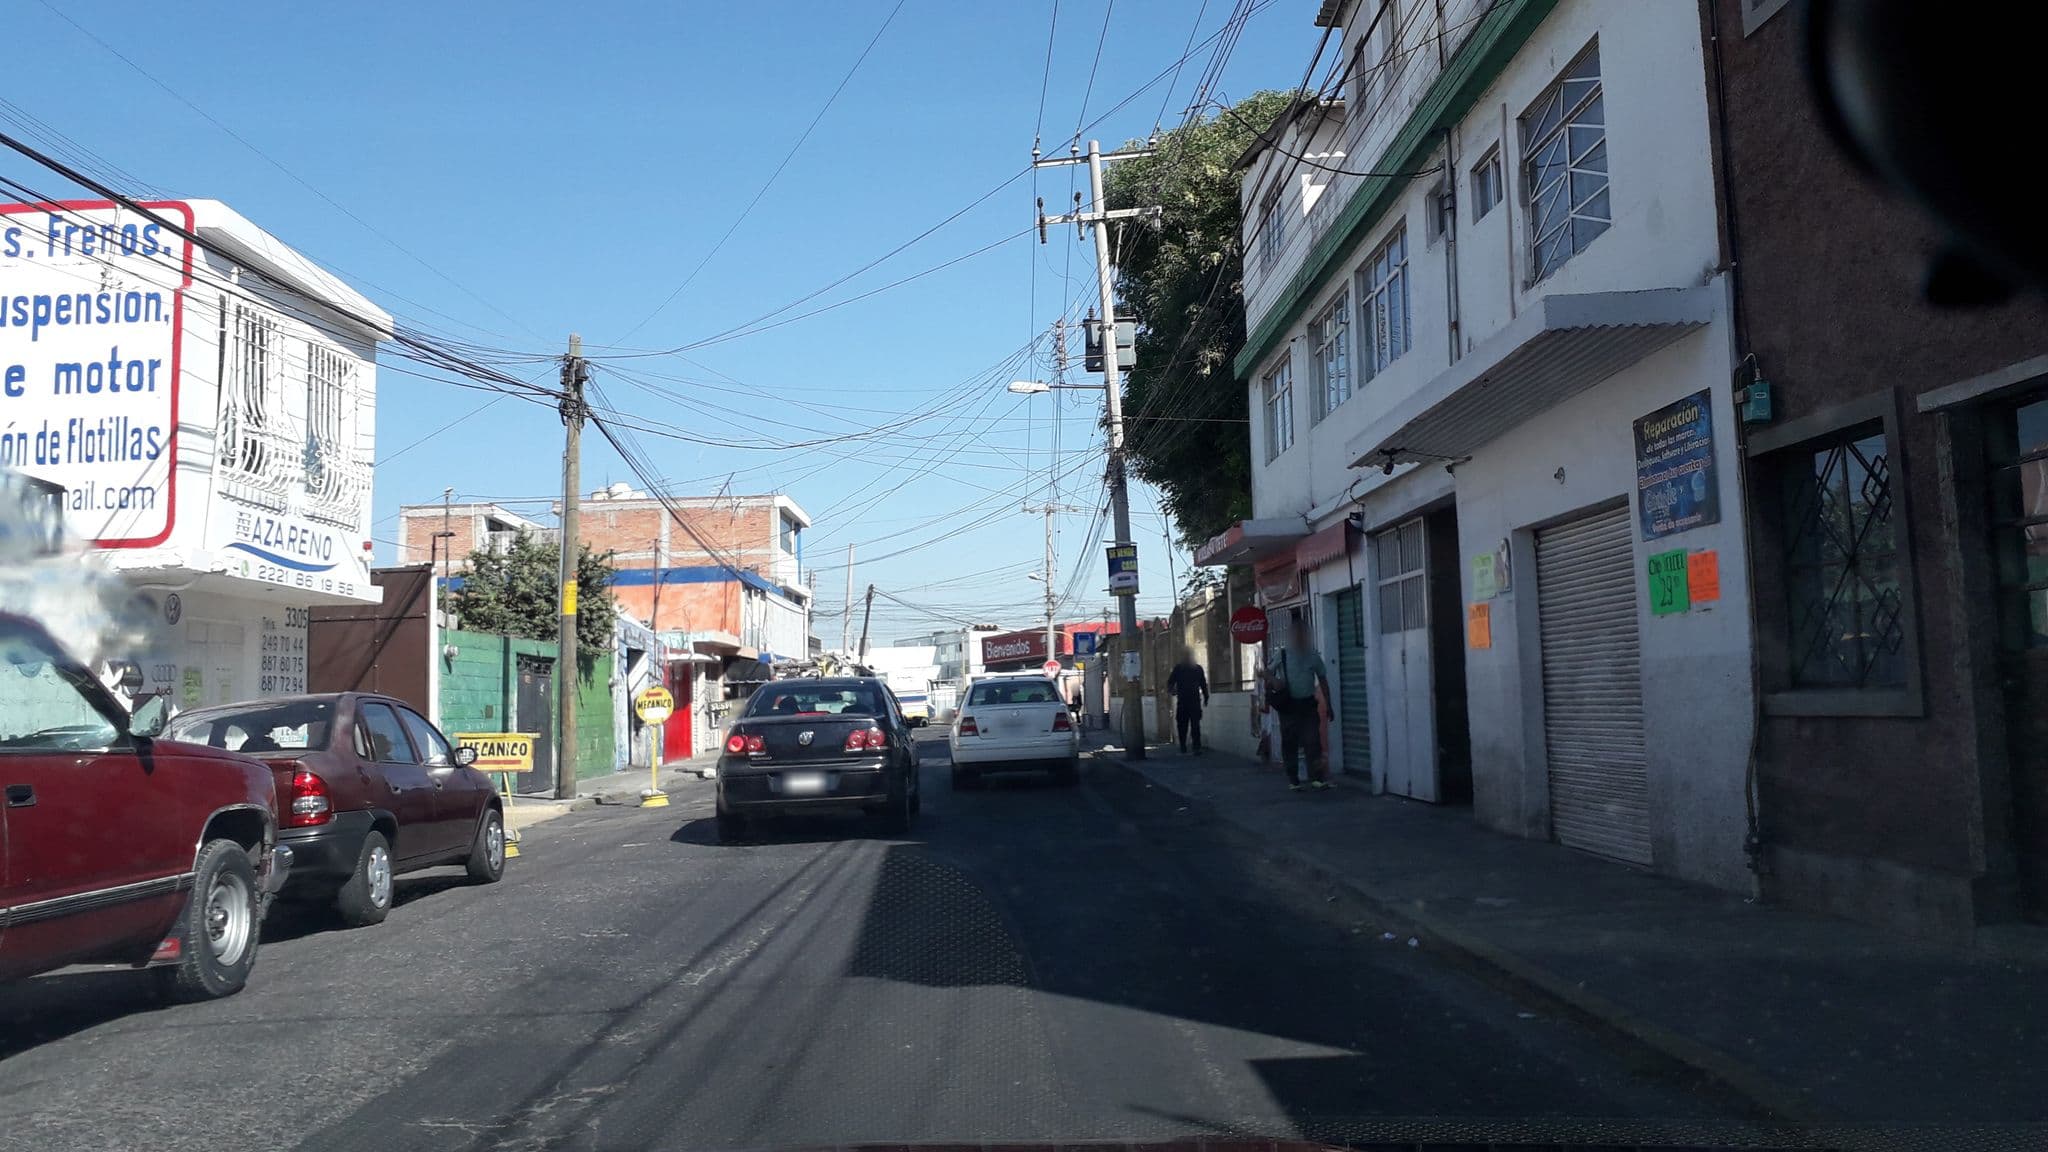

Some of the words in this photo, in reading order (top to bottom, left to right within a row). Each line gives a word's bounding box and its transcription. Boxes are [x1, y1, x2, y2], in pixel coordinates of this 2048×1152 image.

[54, 345, 162, 394] motor
[1643, 403, 1698, 440] Reparación
[35, 419, 60, 465] de
[258, 564, 288, 584] 2221
[295, 572, 314, 588] 86
[293, 637, 304, 653] 44
[985, 639, 1031, 659] Bienvenidos
[292, 656, 304, 673] 75
[280, 675, 290, 692] 72
